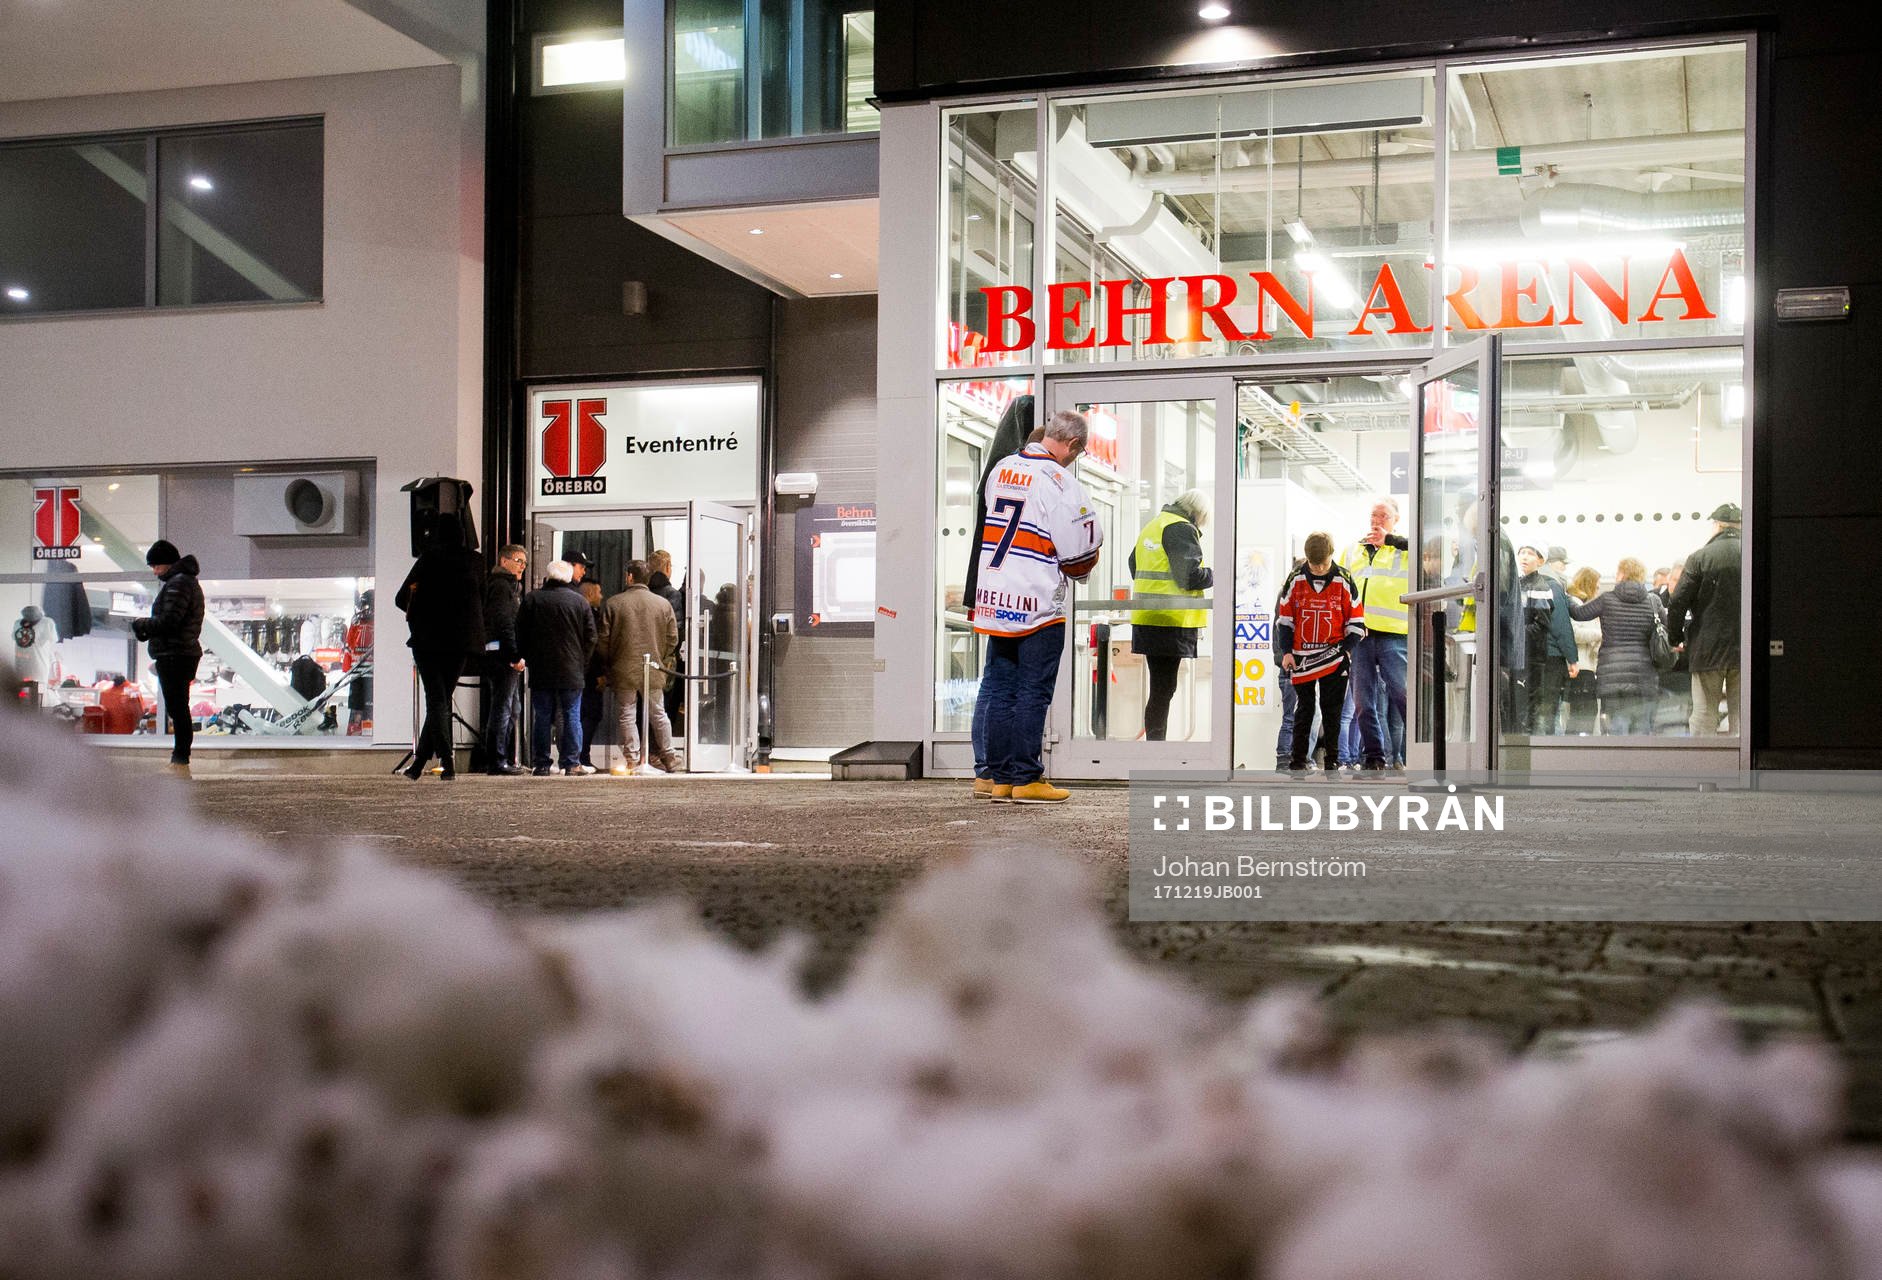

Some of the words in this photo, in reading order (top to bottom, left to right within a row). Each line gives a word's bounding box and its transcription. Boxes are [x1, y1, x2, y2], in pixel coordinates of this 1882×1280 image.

[979, 271, 1314, 353] BEHRN
[1348, 248, 1717, 335] ARENA
[626, 432, 738, 454] Evententré
[543, 478, 604, 494] ÖREBRO
[998, 468, 1033, 487] MAXI
[986, 495, 1027, 571] 7
[1083, 520, 1095, 544] 7
[36, 547, 79, 558] ÖREBRO
